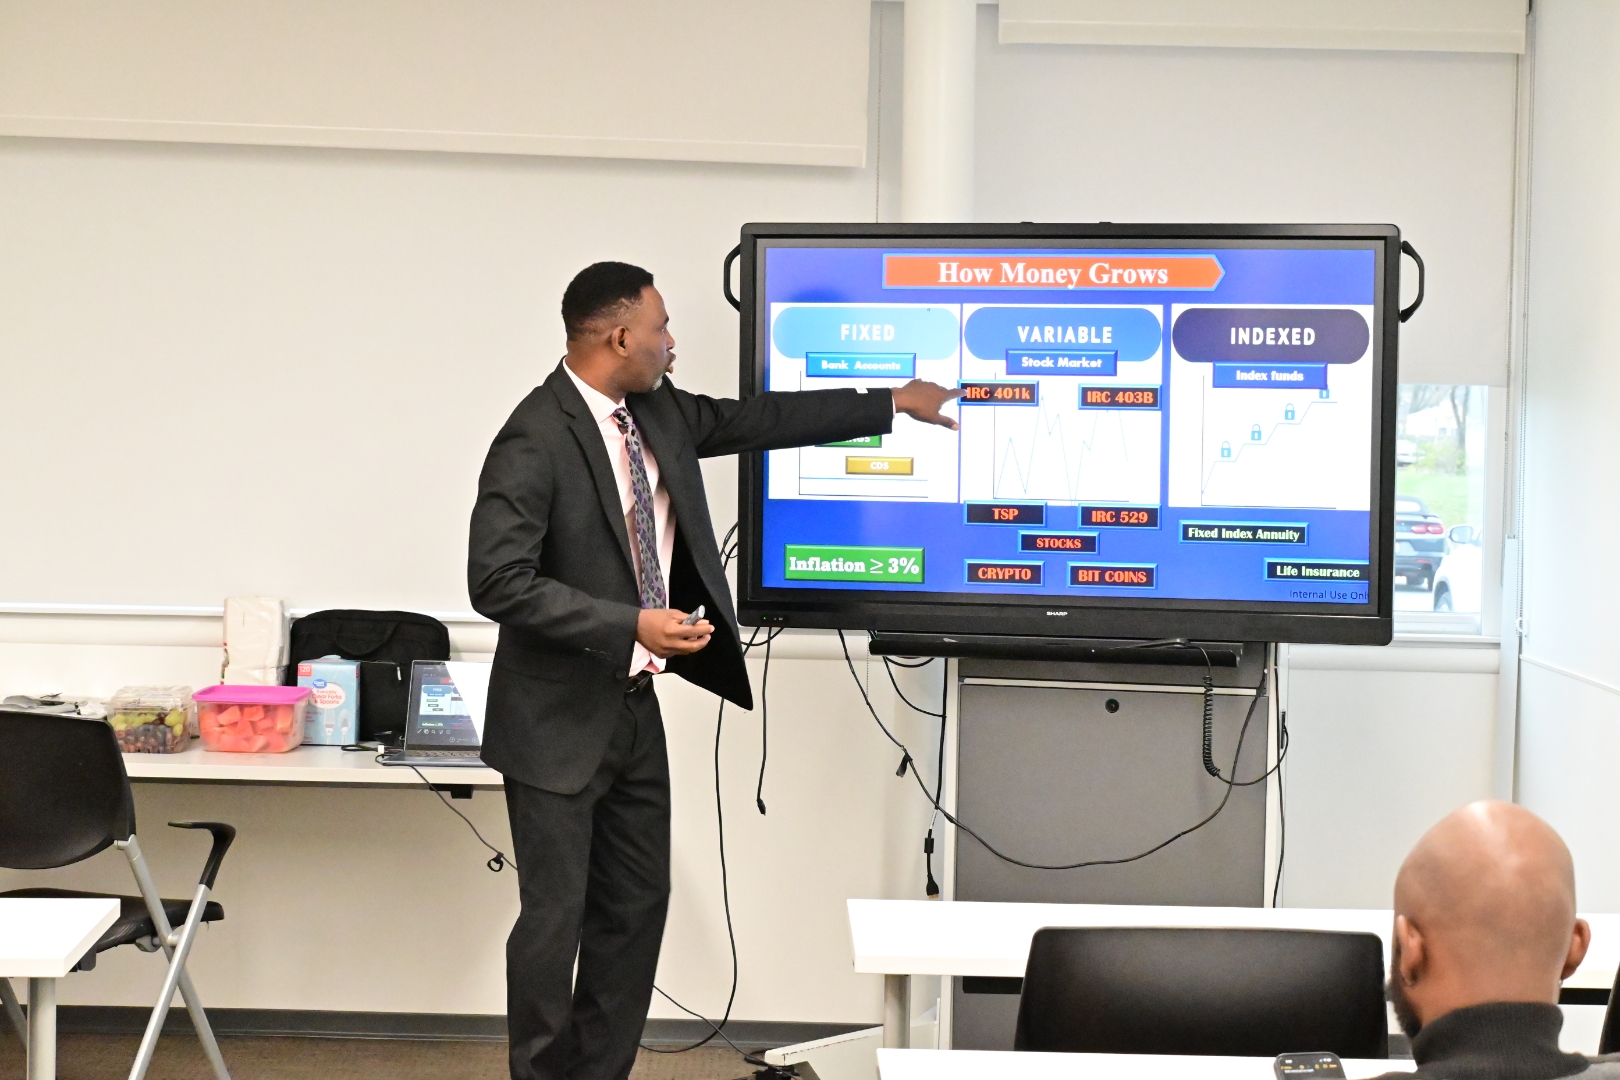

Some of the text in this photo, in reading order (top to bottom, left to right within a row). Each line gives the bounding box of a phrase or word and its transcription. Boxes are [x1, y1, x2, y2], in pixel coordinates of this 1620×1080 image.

[937, 261, 1169, 290] How Money Grows
[840, 323, 895, 341] FIXED
[1016, 325, 1113, 344] VARIABLE
[1230, 326, 1316, 346] INDEXED
[821, 360, 901, 371] Bank Accounts
[1021, 356, 1102, 368] Stock Market
[1236, 369, 1304, 382] Index funds
[966, 386, 1031, 400] IRC 401k
[1086, 390, 1154, 404] IRC 403B
[992, 507, 1019, 521] TSP
[1091, 510, 1148, 524] IRC 529
[1188, 527, 1300, 543] Fixed Index Annuity
[1036, 537, 1082, 549] STOCKS
[788, 556, 866, 573] Inflation
[888, 557, 920, 575] 3%
[1276, 564, 1360, 578] Life Insurance
[977, 567, 1032, 581] CRYPTO
[1078, 569, 1147, 583] BIT COINS
[1289, 589, 1369, 600] Internal Use Onl
